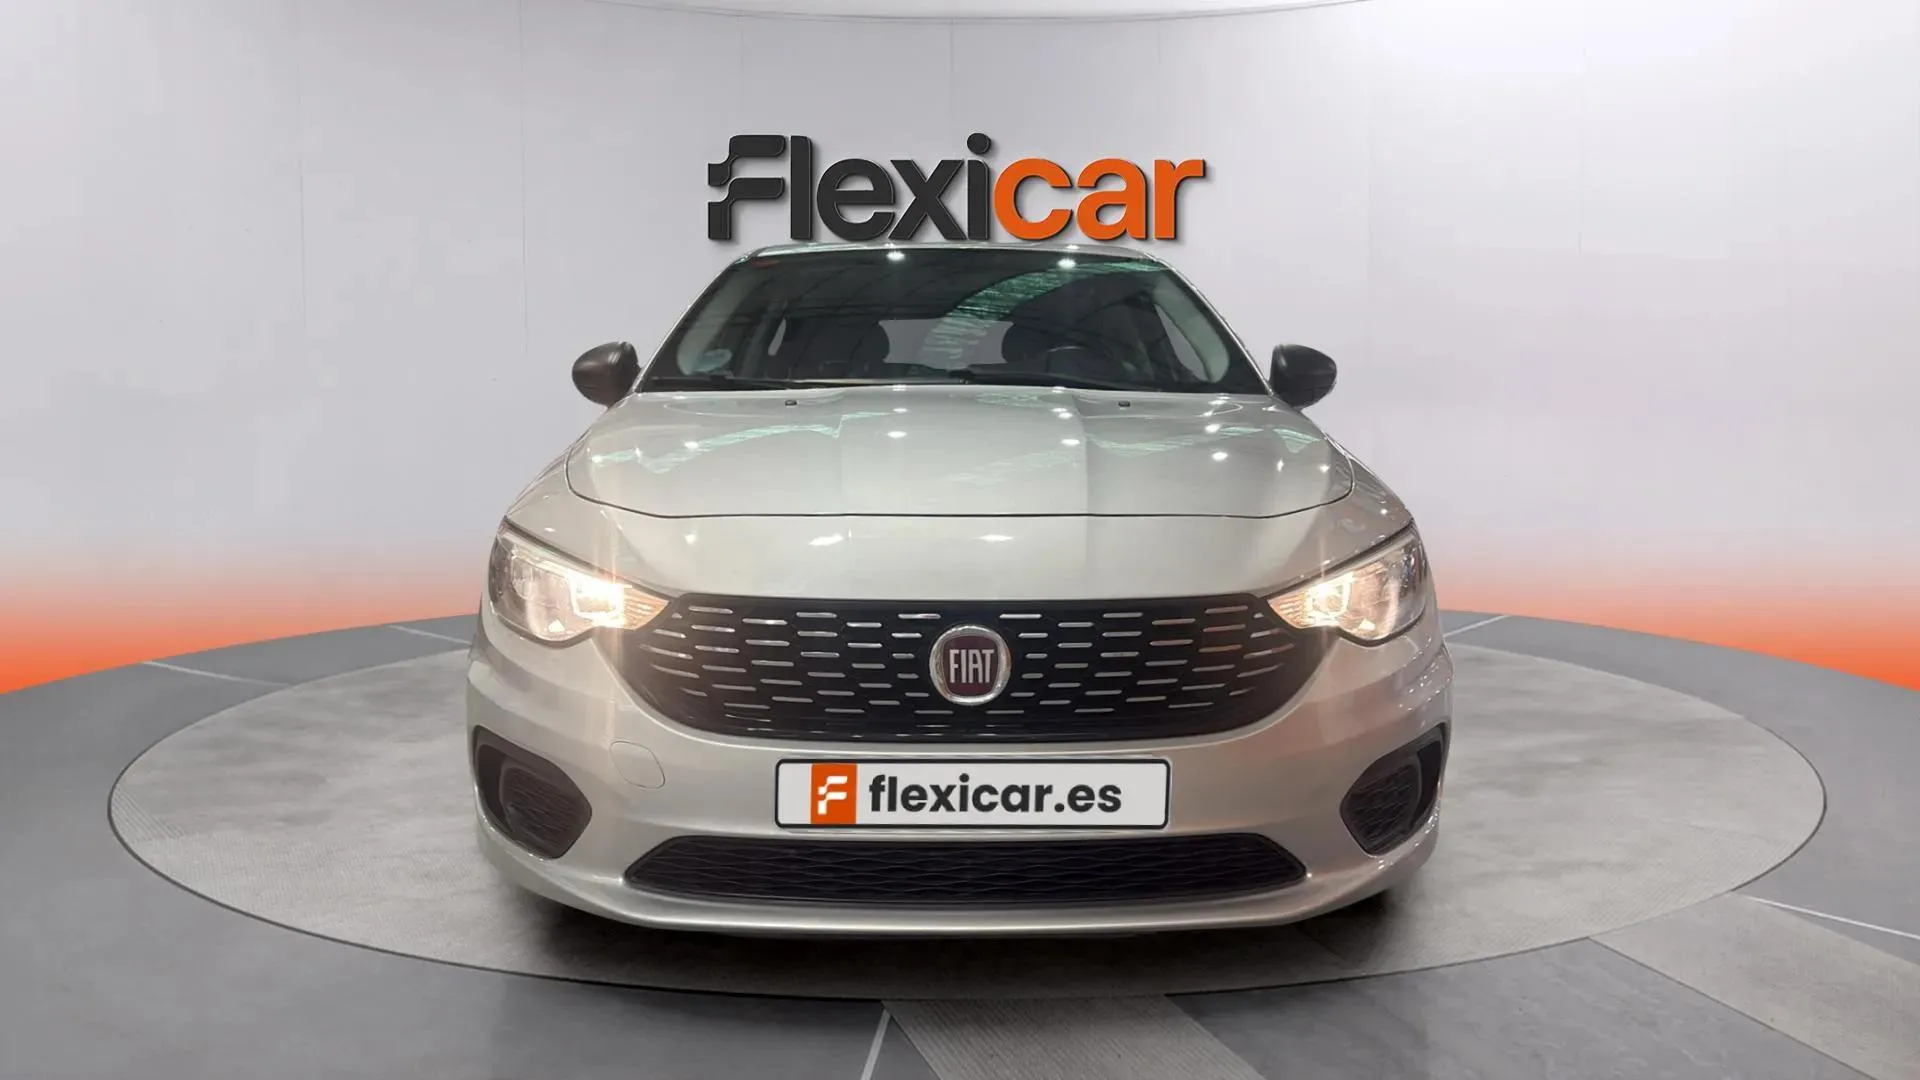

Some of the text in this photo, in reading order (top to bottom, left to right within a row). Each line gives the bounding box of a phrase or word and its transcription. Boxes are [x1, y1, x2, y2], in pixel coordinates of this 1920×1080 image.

[708, 132, 1205, 240] Flexicar
[949, 649, 995, 684] FIAT
[869, 773, 1122, 813] flexicar.es
